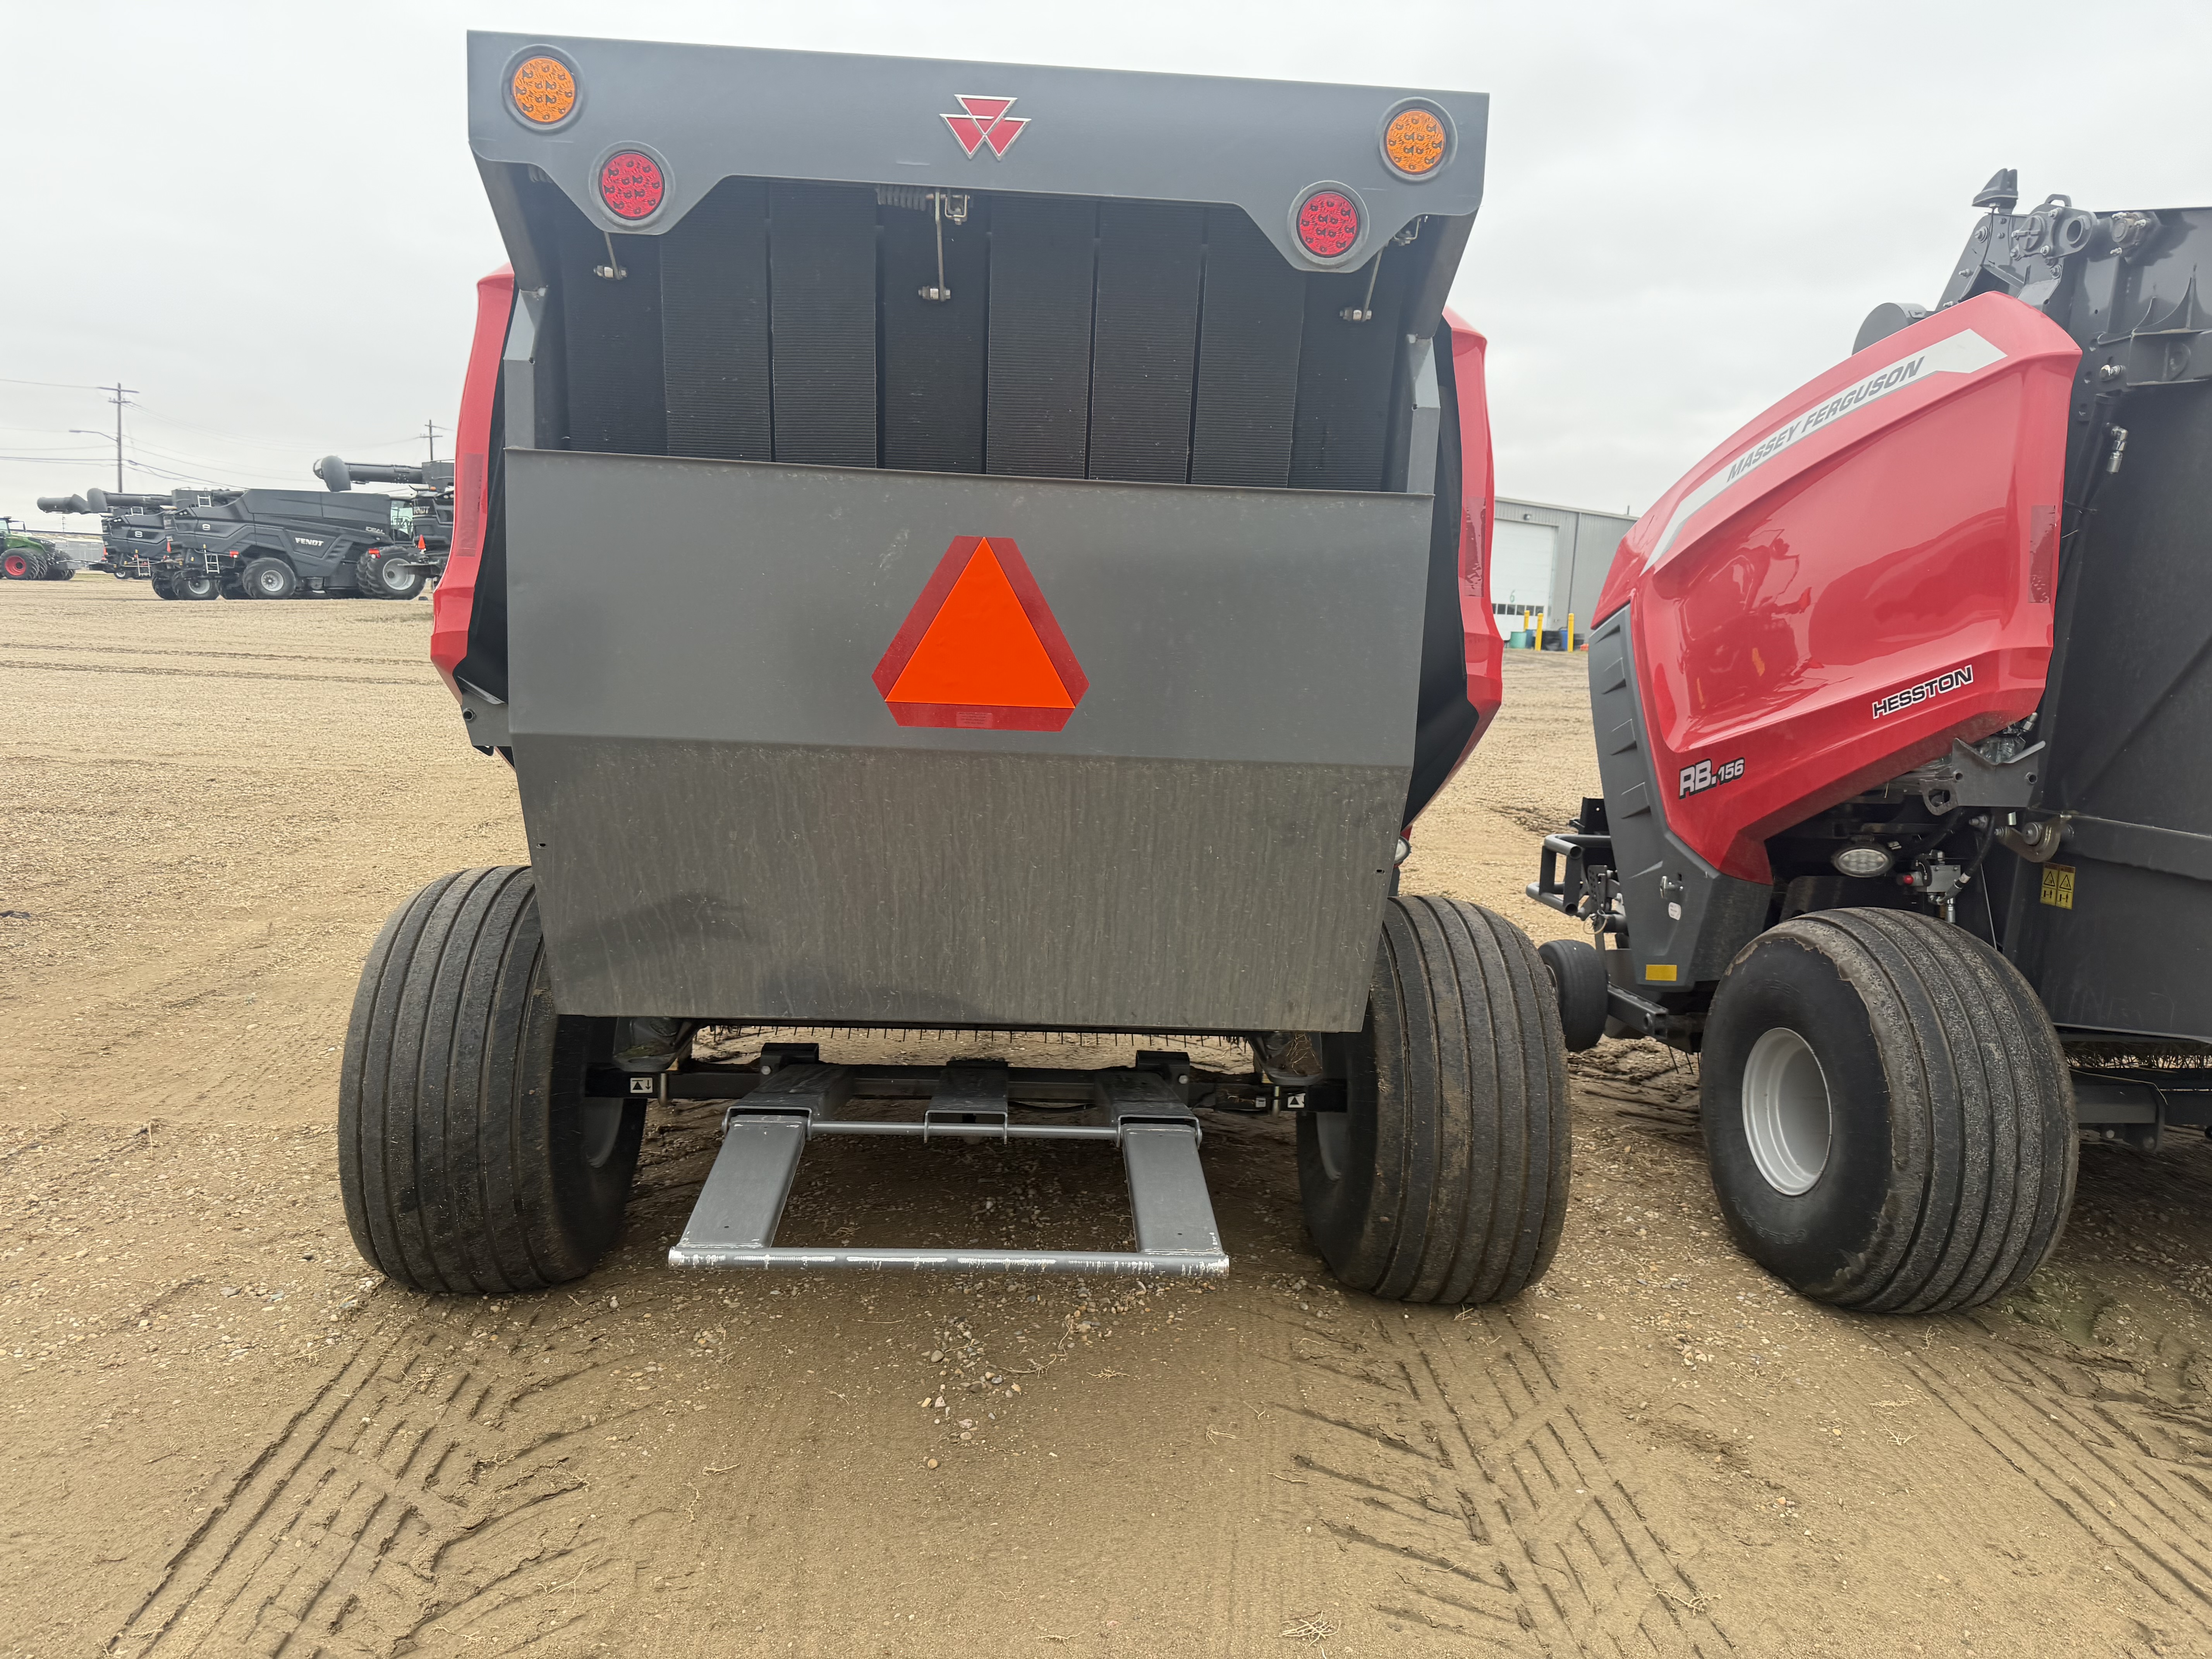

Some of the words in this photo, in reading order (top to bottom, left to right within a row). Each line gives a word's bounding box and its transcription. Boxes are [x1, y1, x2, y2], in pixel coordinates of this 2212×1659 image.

[1726, 420, 1802, 483] MASSEY
[1801, 356, 1925, 433] FERGUSON
[295, 537, 324, 547] FENDT
[1510, 589, 1516, 603] 6
[1872, 665, 1973, 719] HESSTON
